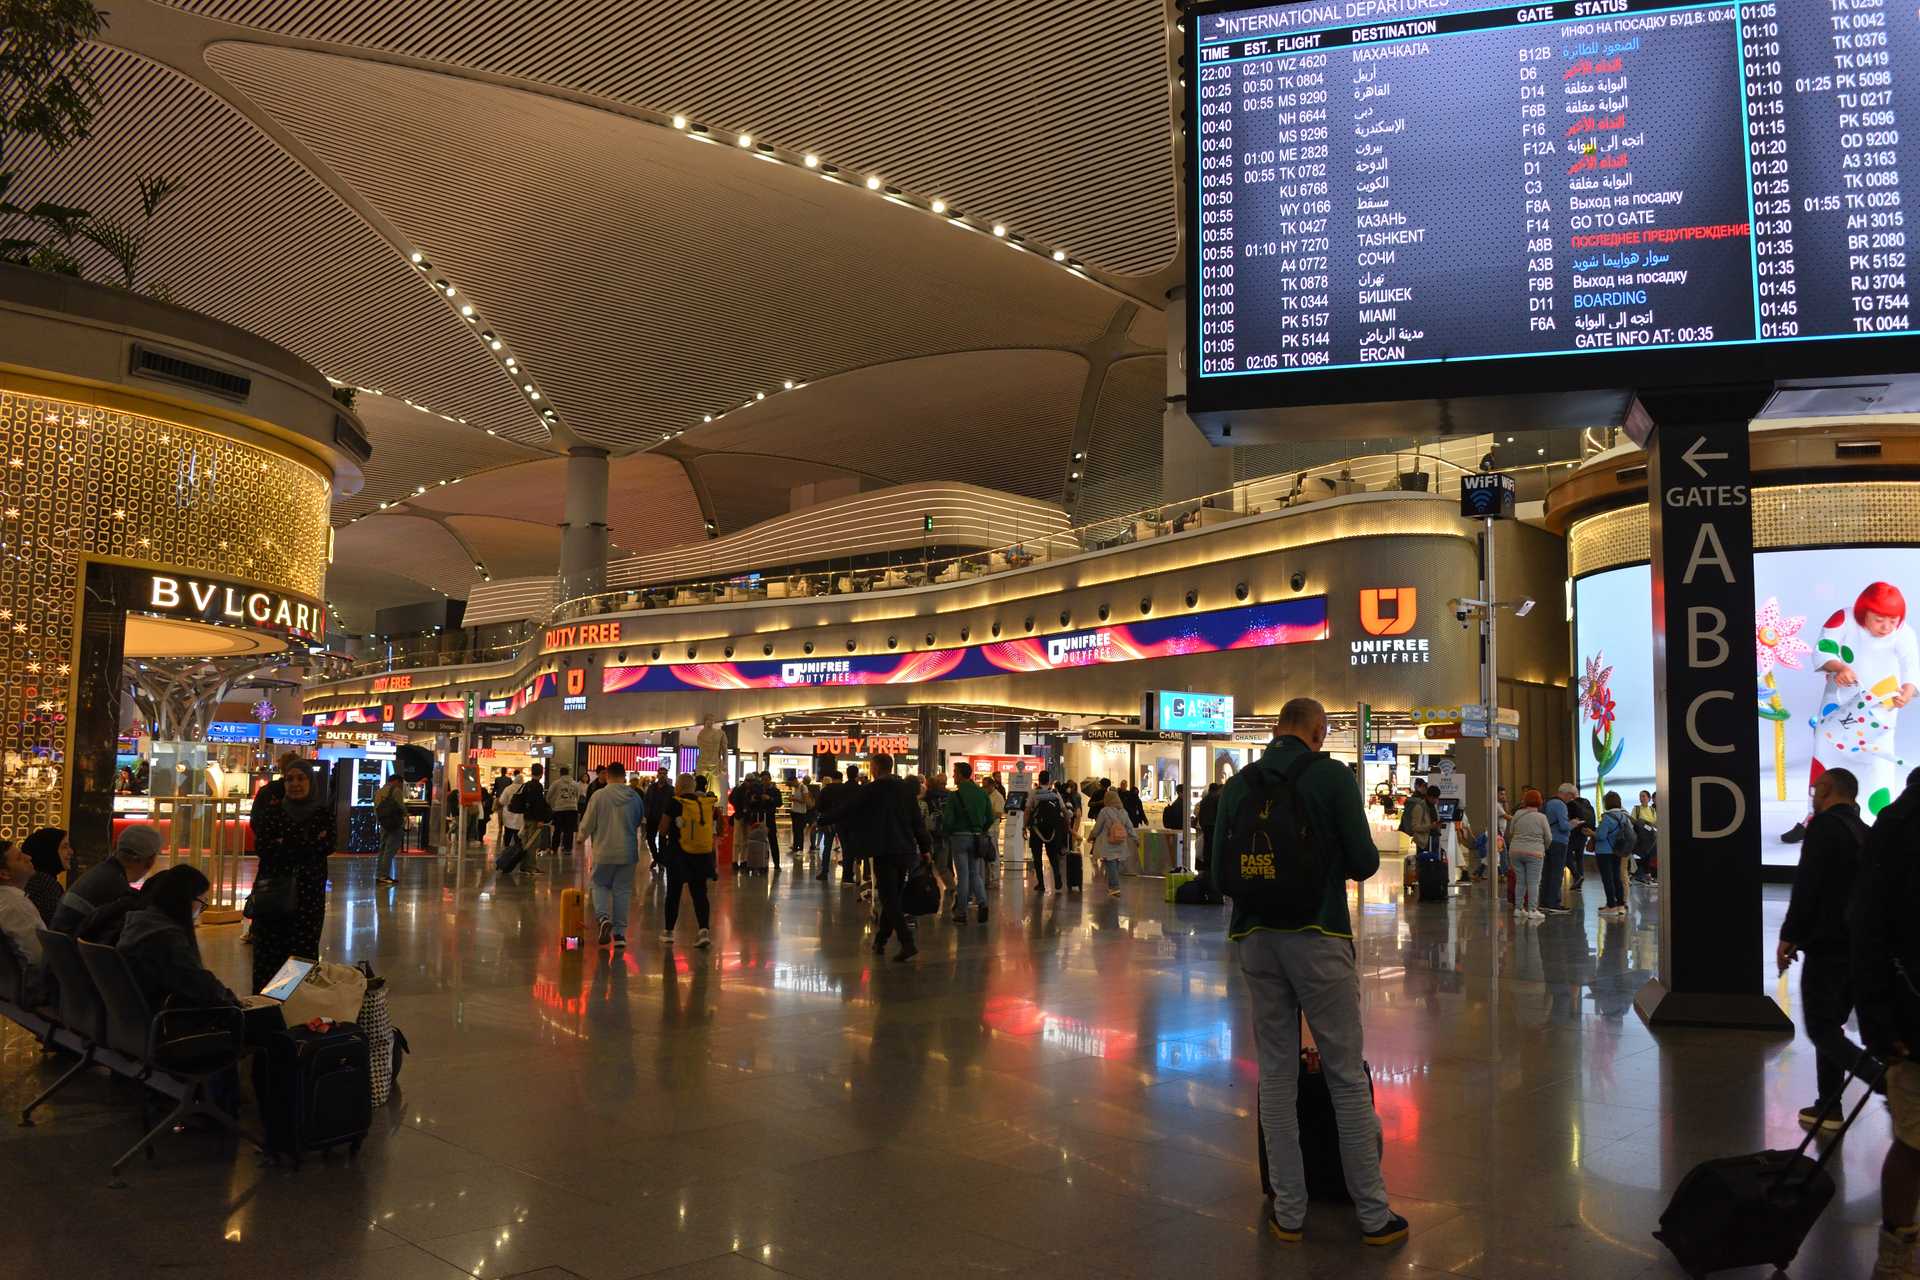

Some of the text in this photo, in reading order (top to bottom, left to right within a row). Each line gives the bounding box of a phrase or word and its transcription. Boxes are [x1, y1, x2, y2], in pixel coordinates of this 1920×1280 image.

[1517, 6, 1554, 23] GATE
[1574, 0, 1628, 16] STATUS
[1225, 8, 1342, 34] INTERNATIONAL
[1561, 23, 1593, 37] ИНФО
[1596, 21, 1612, 33] НА
[1614, 14, 1667, 34] ПОСАДКУ
[1352, 20, 1437, 42] DESTINATION
[1244, 40, 1271, 56] EST.
[1277, 34, 1321, 52] FLIGHT
[1201, 46, 1230, 62] TIME
[1353, 41, 1429, 62] МАХАЧКАЛА
[1519, 46, 1550, 61] B12B
[1242, 60, 1272, 75] 02:10
[1277, 53, 1326, 71] WZ 4620
[1201, 65, 1231, 81] 22:00
[1278, 72, 1323, 89] TK 0804
[1519, 66, 1536, 80] D6
[1836, 70, 1890, 88] PK 5098
[1201, 83, 1231, 98] 00:25
[1243, 78, 1273, 93] 00:50
[1520, 84, 1544, 99] D14
[1746, 79, 1782, 97] 01:10
[1795, 75, 1831, 92] 01:25
[1243, 95, 1273, 111] 00:55
[1278, 89, 1326, 107] MS 9290
[1201, 100, 1231, 116] 00:40
[1521, 103, 1545, 118] F6B
[1278, 108, 1326, 125] NH 6644
[1202, 118, 1231, 134] 00:40
[1522, 122, 1545, 137] F16
[1279, 126, 1327, 143] MS 9296
[1202, 136, 1232, 152] 00:40
[1523, 140, 1555, 156] F12A
[1244, 149, 1274, 165] 01:00
[1279, 144, 1328, 161] ME 2828
[1202, 154, 1232, 169] 00:45
[1524, 160, 1539, 175] D1
[1244, 168, 1274, 183] 00:55
[1279, 162, 1325, 179] TK 0782
[1202, 172, 1232, 187] 00:45
[1524, 180, 1542, 194] C3
[1279, 181, 1327, 198] KU 6768
[1202, 190, 1232, 206] 00:50
[1525, 198, 1550, 213] F8A
[1569, 190, 1683, 212] Выход на посадку
[1803, 195, 1840, 211] 01:55
[1844, 190, 1900, 208] TK 0026
[1279, 199, 1330, 216] WY 0166
[1754, 198, 1790, 215] 01:25
[1202, 209, 1233, 224] 00:55
[1357, 211, 1406, 228] КАЗАНЬ
[1570, 209, 1655, 229] GO TO GATE
[1280, 218, 1326, 235] TK 0427
[1526, 218, 1549, 232] F14
[1203, 227, 1233, 242] 00:55
[1357, 228, 1425, 247] TASHKENT
[1203, 245, 1233, 260] 00:55
[1245, 241, 1276, 256] 01:10
[1281, 237, 1328, 253] HY 7270
[1526, 237, 1552, 252] A8B
[1280, 255, 1327, 272] A4 0772
[1357, 250, 1394, 266] СОЧИ
[1527, 256, 1553, 272] A3B
[1203, 264, 1233, 279] 01:00
[1203, 282, 1233, 297] 01:00
[1281, 274, 1328, 291] TK 0878
[1528, 276, 1553, 291] F9B
[1281, 293, 1328, 310] TK 0344
[1358, 287, 1411, 304] БИШКЕК
[1529, 296, 1552, 311] D11
[1573, 289, 1647, 309] BOARDING
[1203, 301, 1233, 316] 01:00
[1359, 307, 1395, 323] MIAMI
[1203, 319, 1233, 334] 01:05
[1281, 312, 1329, 328] PK 5157
[1530, 315, 1555, 331] F6A
[1282, 331, 1329, 347] PK 5144
[1575, 325, 1713, 348] GATE INFO AT: 00:35
[1203, 338, 1234, 353] 01:05
[1360, 345, 1404, 362] ERCAN
[1203, 357, 1234, 372] 01:05
[1246, 354, 1277, 369] 02:05
[1281, 350, 1329, 366] TK 0964
[1464, 475, 1498, 489] WiFi
[1666, 486, 1747, 507] GATES
[1682, 523, 1736, 584] A
[151, 576, 317, 633] BVLGARI
[545, 622, 620, 649] DUTY FREE
[1065, 632, 1111, 651] UNIFREE
[1687, 606, 1730, 668] B
[1351, 639, 1429, 653] UNIFREE
[1351, 652, 1429, 665] DUTYFREE
[800, 661, 850, 673] UNIFREE
[390, 676, 411, 689] FREE
[800, 673, 849, 683] DUTYFREE
[1686, 690, 1736, 753] C
[326, 732, 379, 740] DUTY FREE
[1088, 730, 1120, 739] CHANEL
[816, 736, 910, 755] DUTY FREE
[1691, 776, 1746, 838] D
